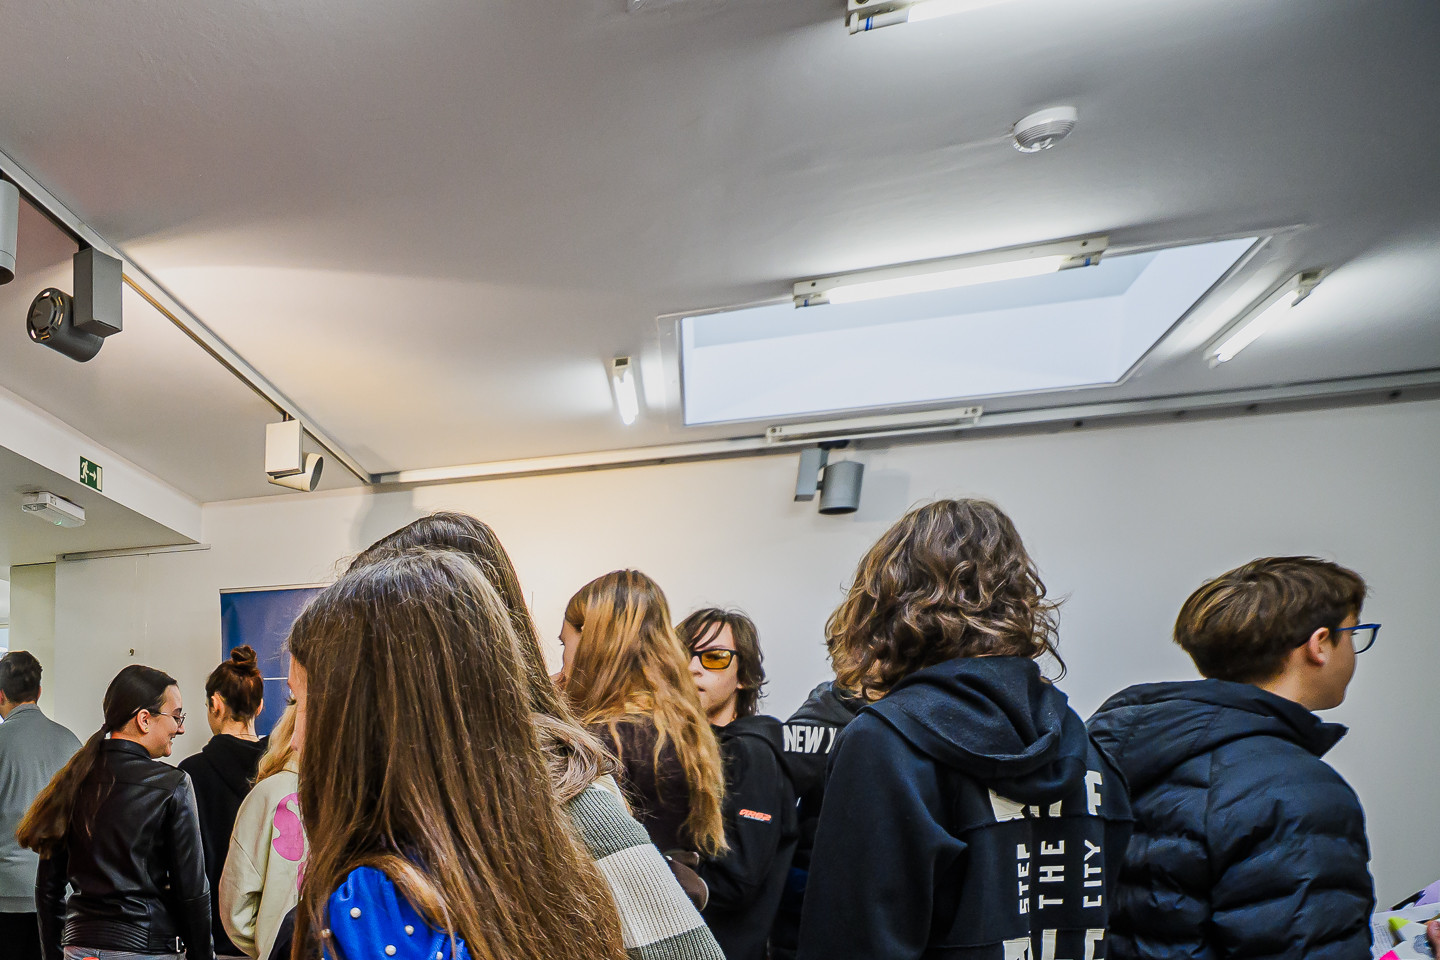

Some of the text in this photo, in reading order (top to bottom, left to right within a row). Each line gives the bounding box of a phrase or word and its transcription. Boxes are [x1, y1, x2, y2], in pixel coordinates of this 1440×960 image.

[782, 724, 837, 754] NEW Y
[1016, 843, 1030, 914] STEP
[1038, 839, 1065, 909] THE
[1082, 839, 1102, 908] CITY
